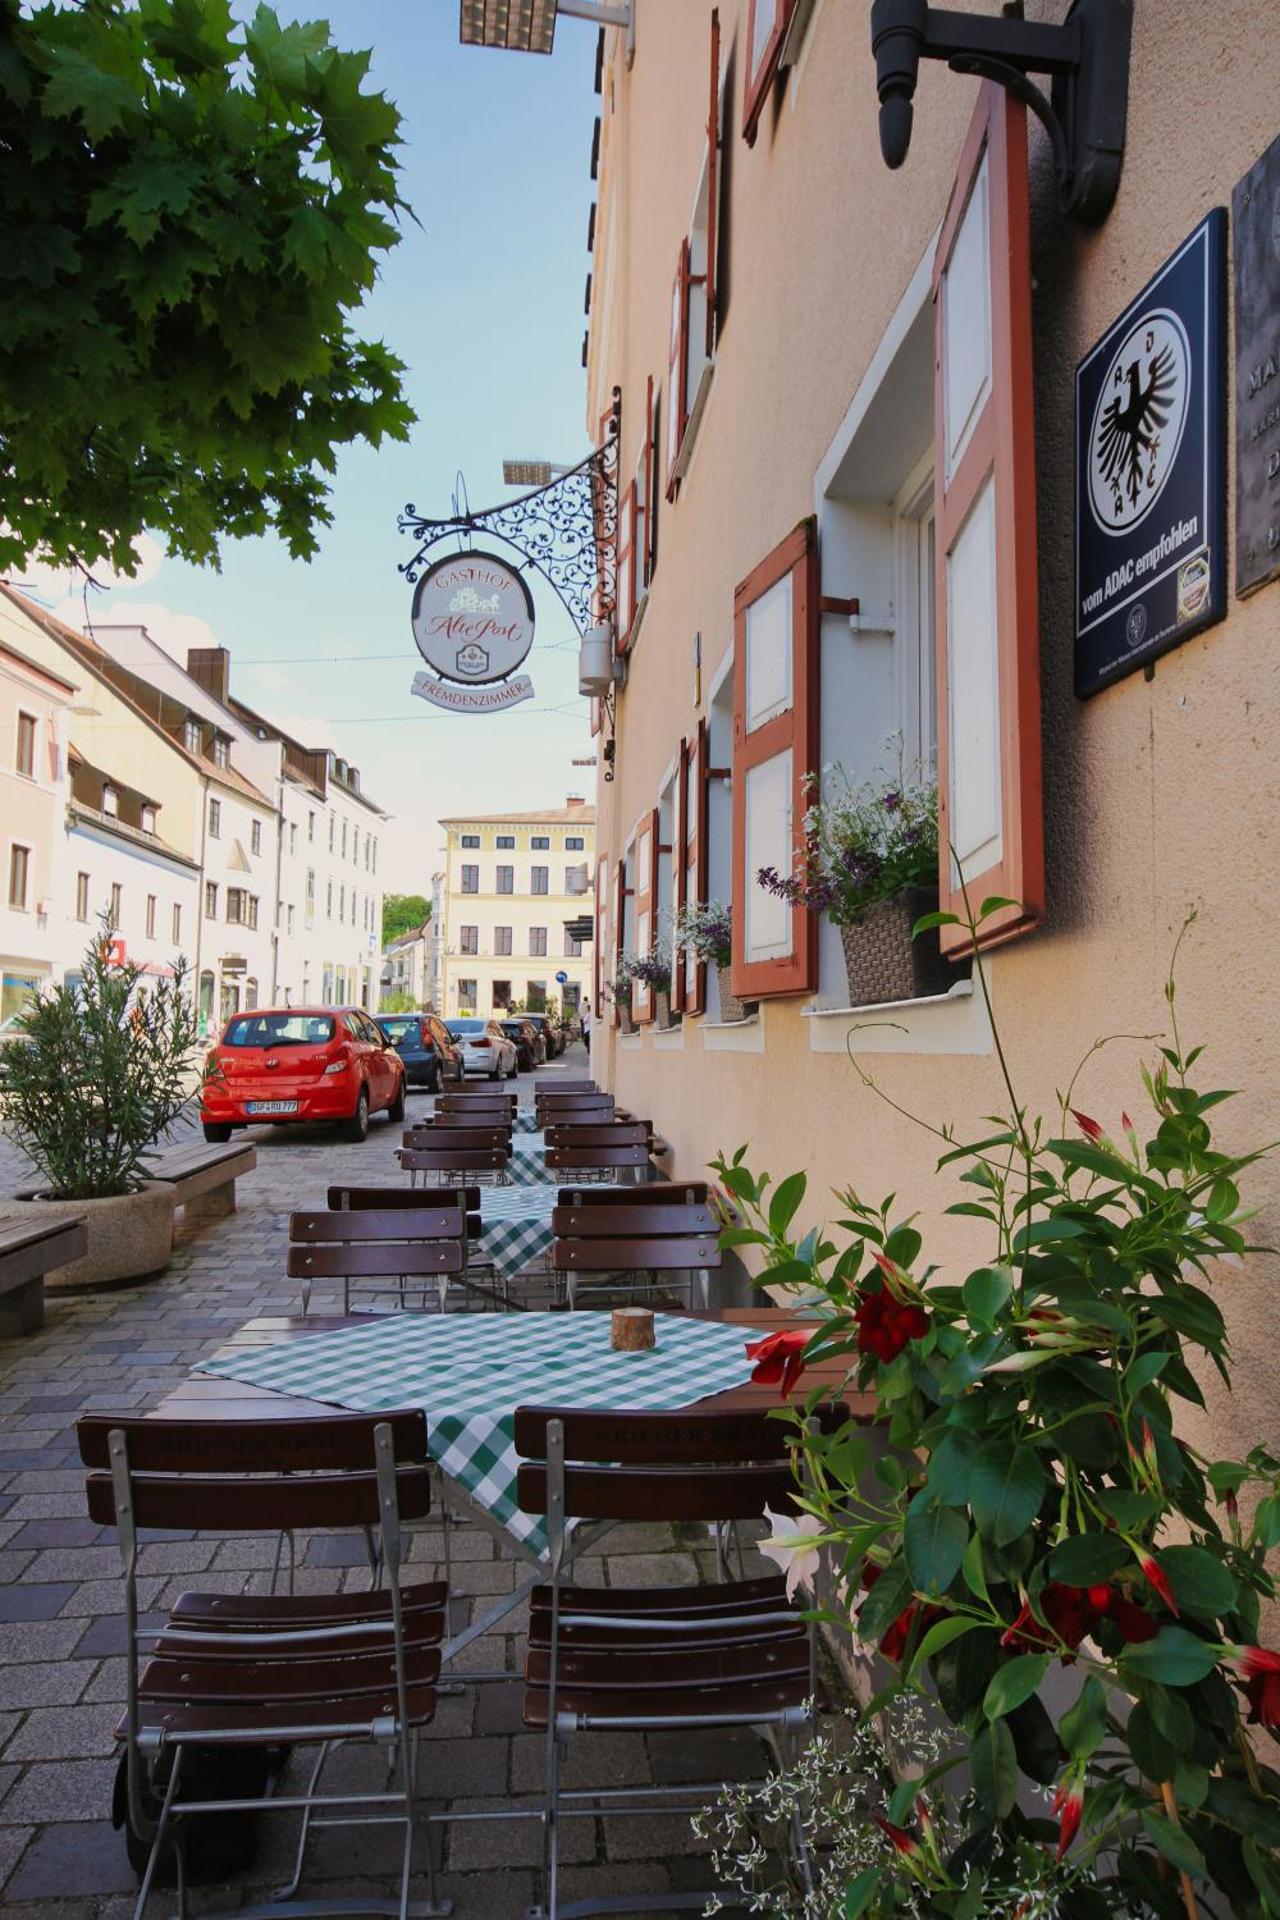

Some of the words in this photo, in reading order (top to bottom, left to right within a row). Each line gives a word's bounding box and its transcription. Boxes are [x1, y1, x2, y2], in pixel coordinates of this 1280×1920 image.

[1082, 588, 1103, 615] vom
[1104, 558, 1134, 600] ADAC
[1135, 516, 1198, 576] empfohlen
[435, 567, 513, 591] GASTHOF
[425, 615, 474, 639] Alte
[463, 618, 523, 642] Post
[421, 680, 526, 706] FREMDENZIMMER
